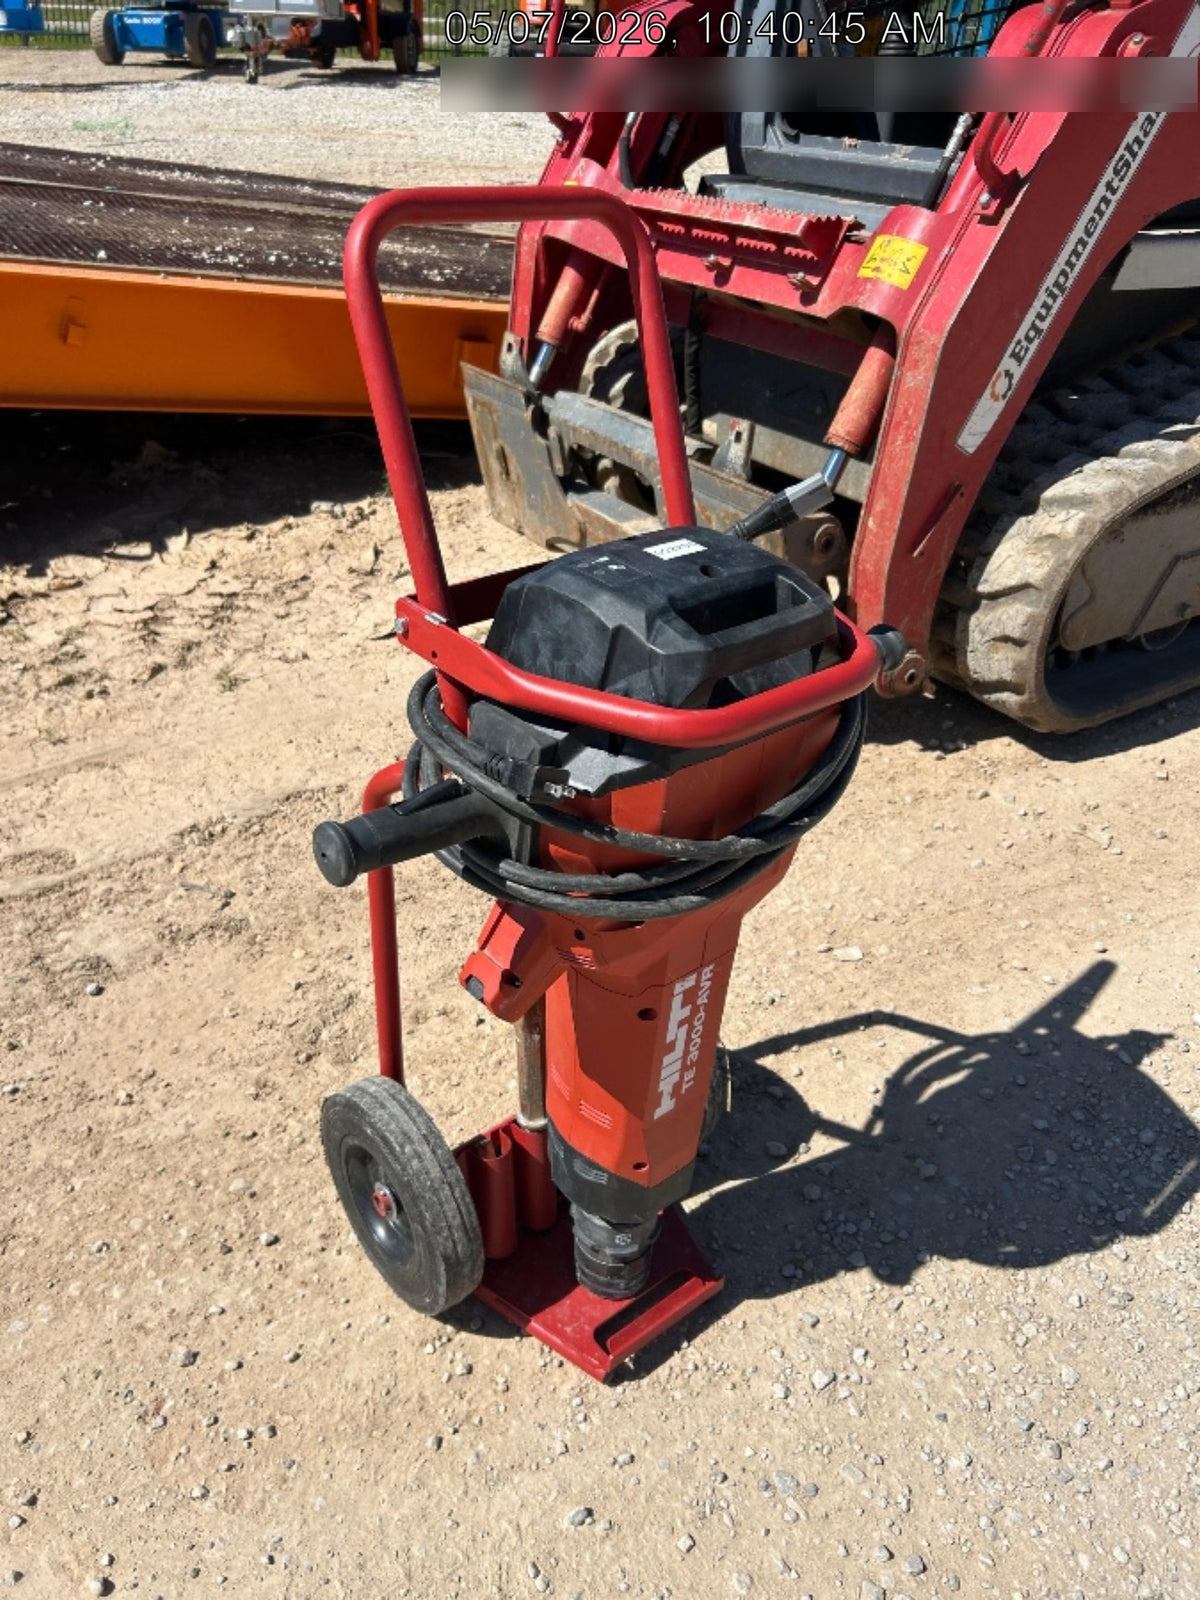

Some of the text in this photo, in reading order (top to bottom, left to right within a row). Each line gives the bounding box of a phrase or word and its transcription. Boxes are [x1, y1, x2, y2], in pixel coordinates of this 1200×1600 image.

[1009, 112, 1161, 367] EquipmentSha
[654, 973, 698, 1120] HILTI
[681, 963, 715, 1094] TE 3000-AVR
